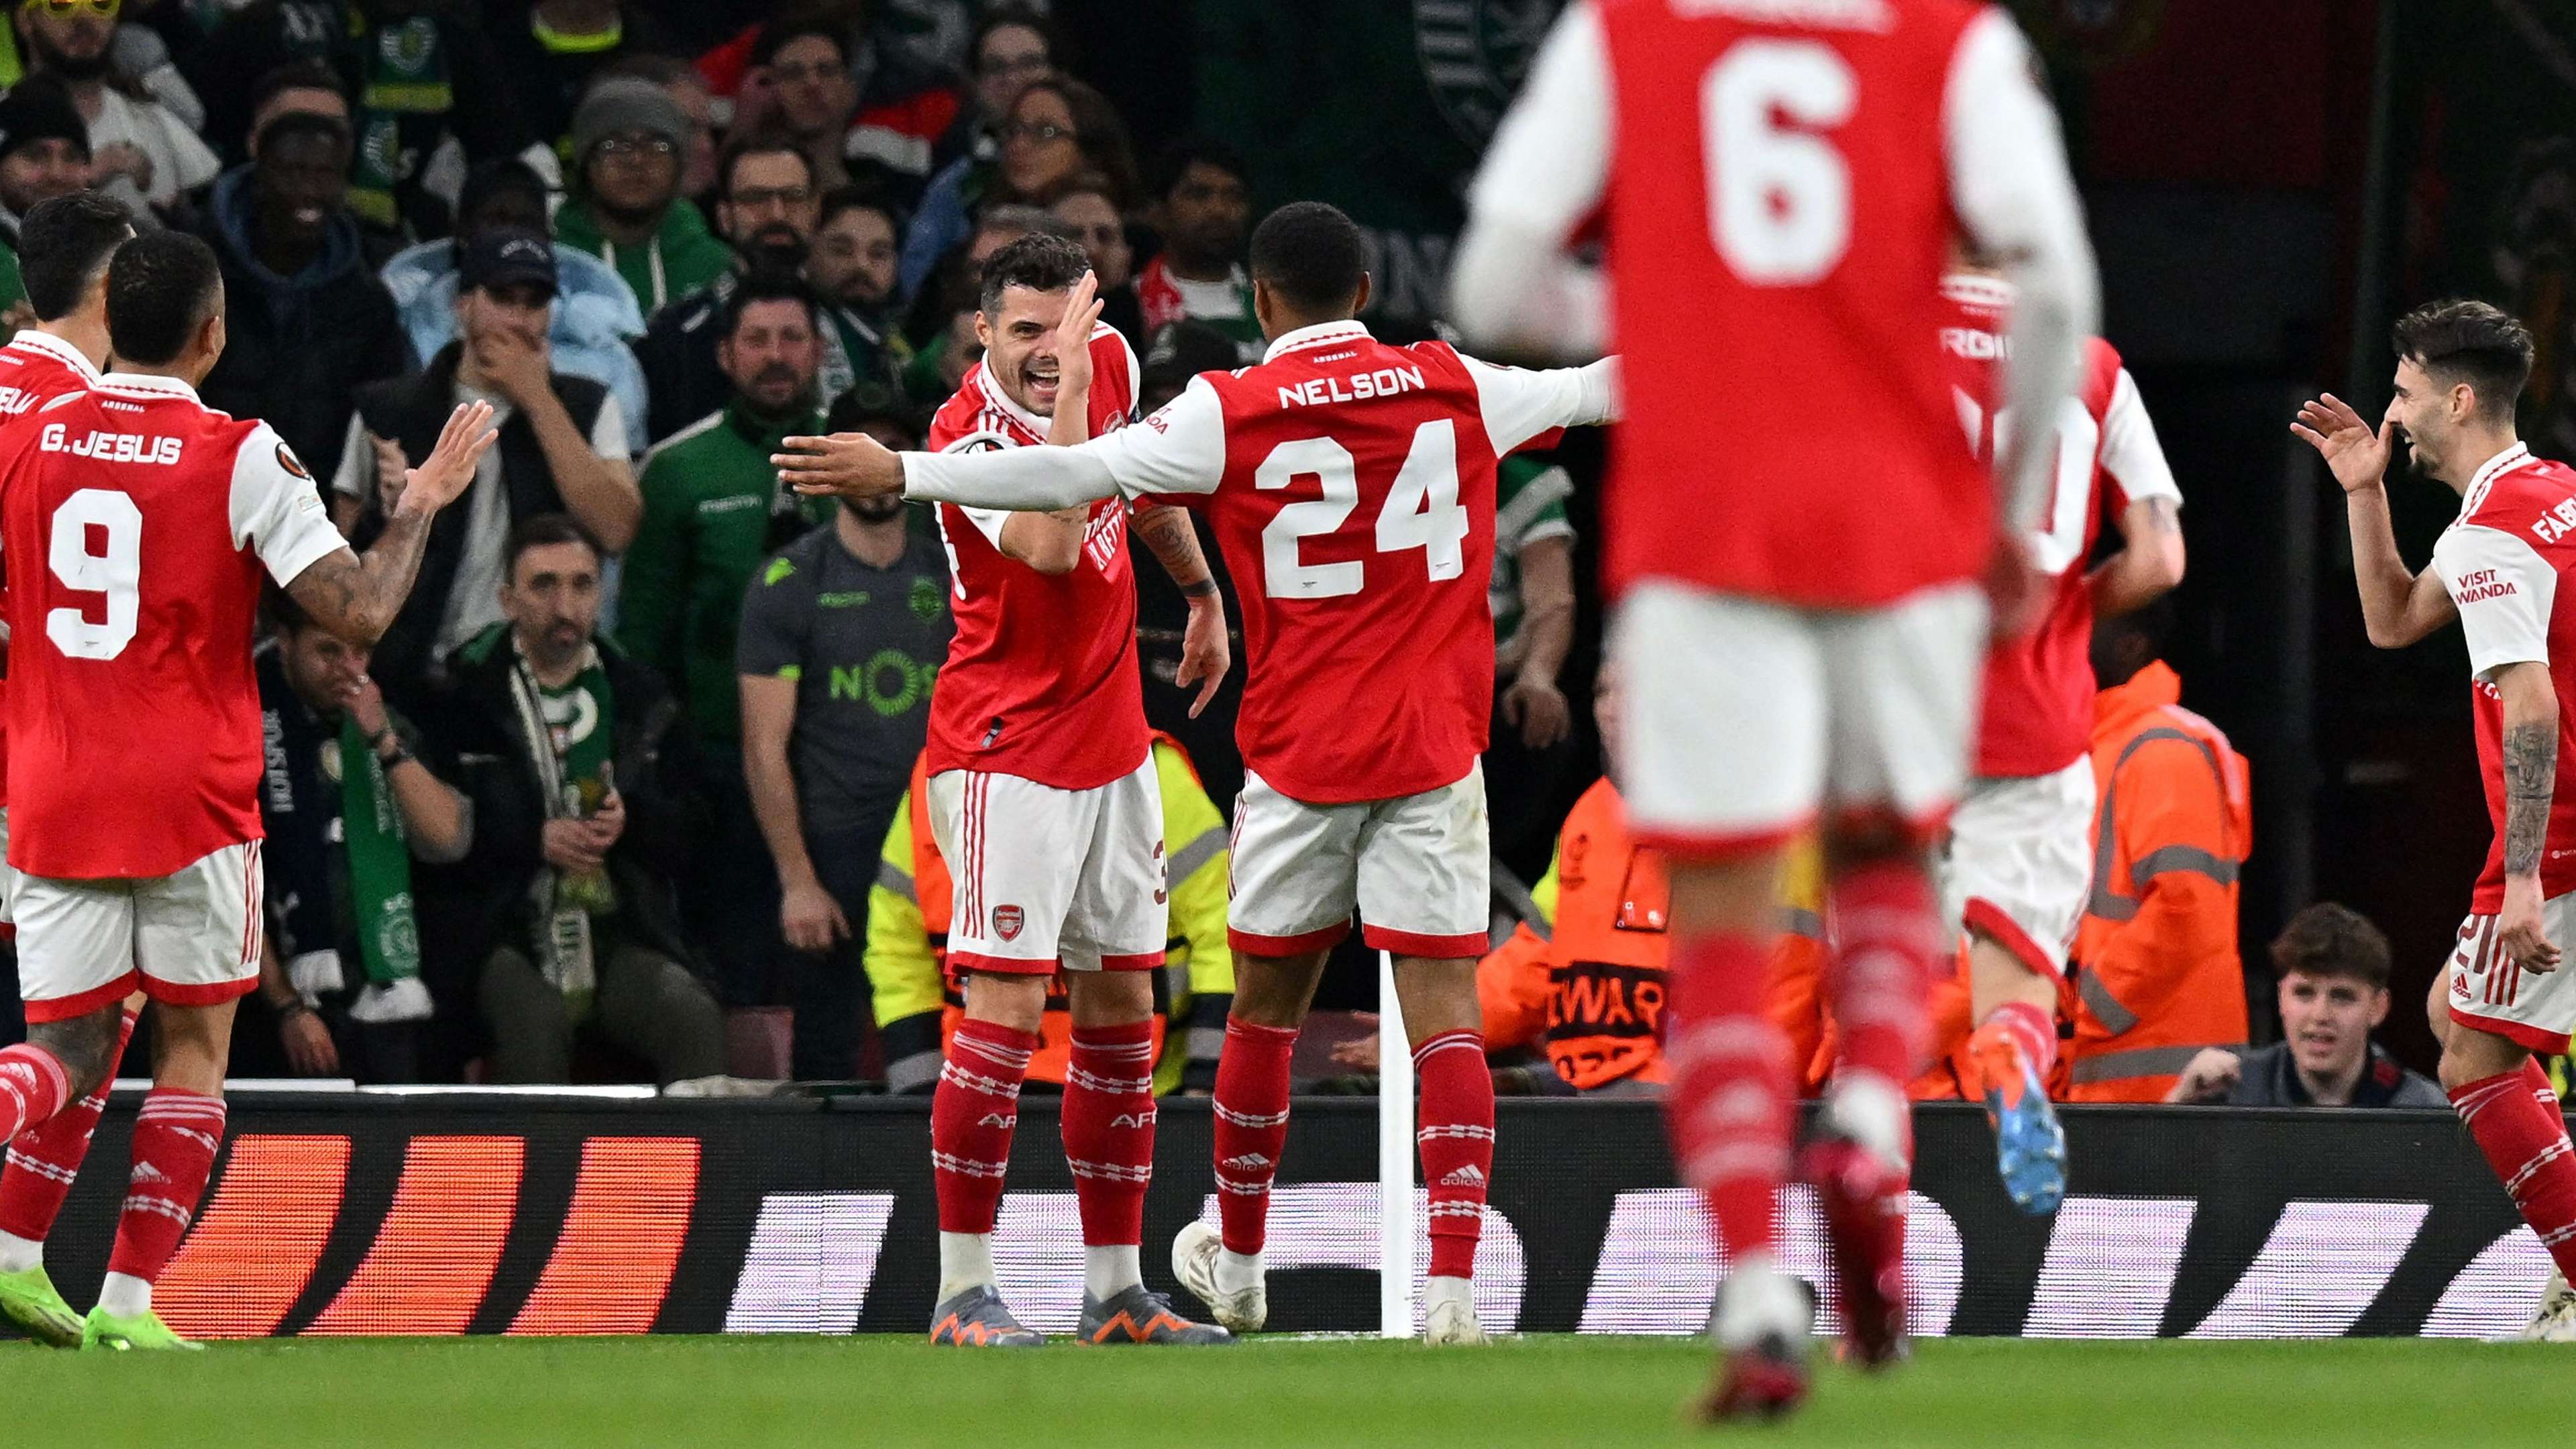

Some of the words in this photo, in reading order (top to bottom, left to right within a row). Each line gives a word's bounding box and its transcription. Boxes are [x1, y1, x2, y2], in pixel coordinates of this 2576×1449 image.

[1699, 34, 1862, 288] 6
[1313, 350, 1358, 364] ARSENAL
[1277, 365, 1426, 410] NELSON
[101, 400, 146, 413] ARSENAL
[40, 423, 183, 466] G.JESUS
[1254, 418, 1470, 600] 24
[46, 488, 144, 661] 9
[2457, 569, 2497, 589] VISIT
[2455, 582, 2518, 606] WANDA
[1440, 1173, 1487, 1189] adidas
